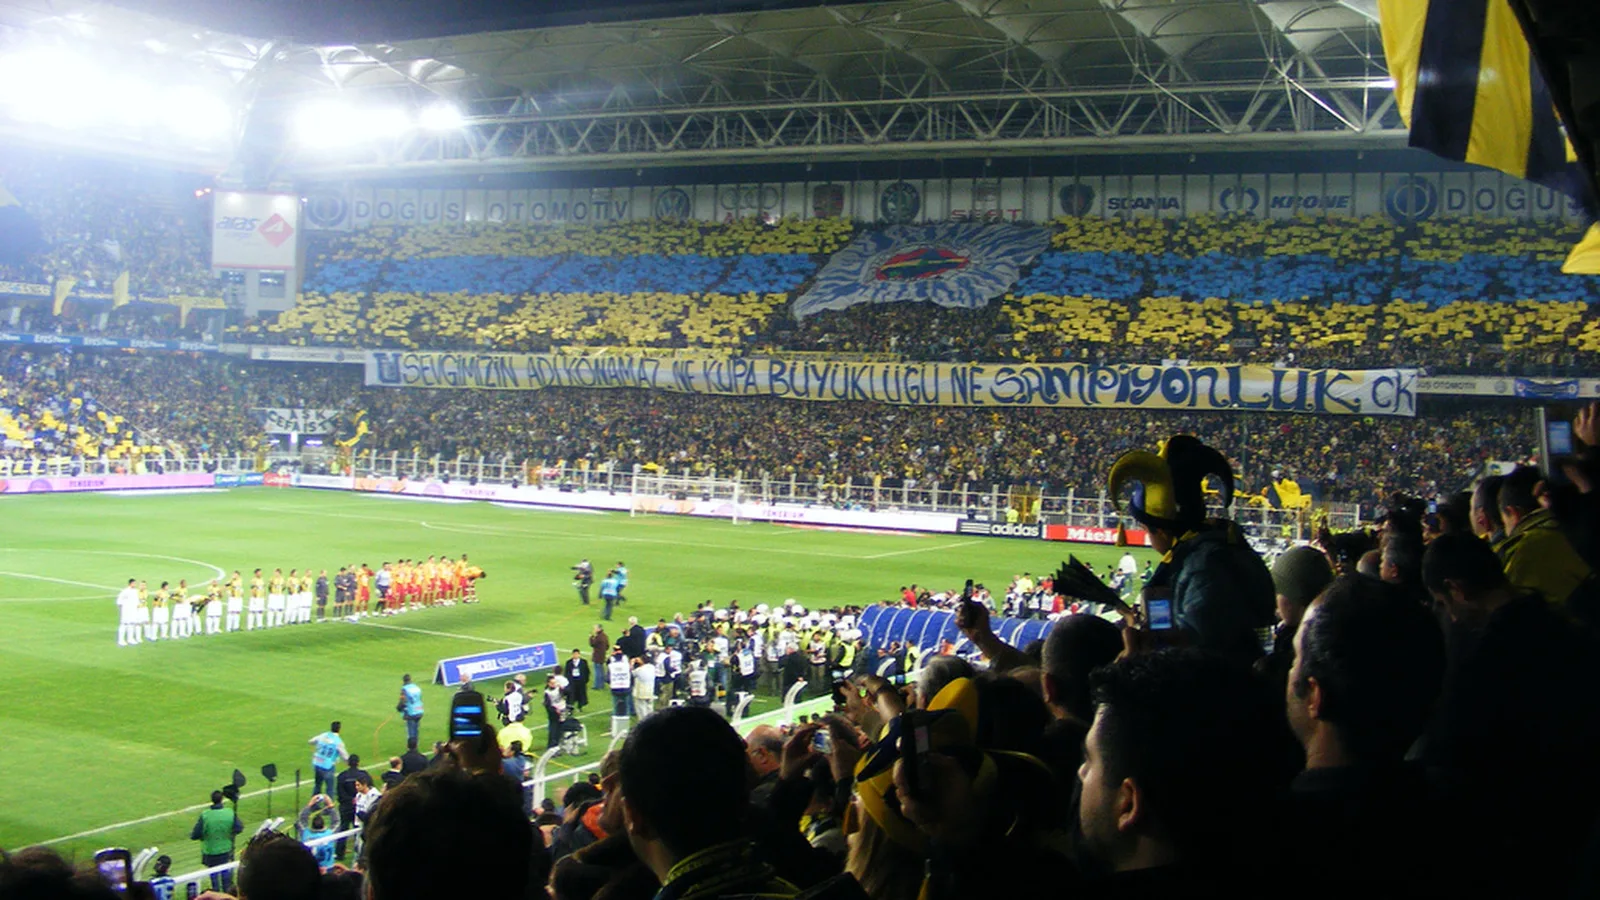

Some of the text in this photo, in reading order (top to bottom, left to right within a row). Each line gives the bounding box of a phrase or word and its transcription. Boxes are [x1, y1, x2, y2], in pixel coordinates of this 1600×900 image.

[1107, 196, 1180, 210] SCANIA
[1270, 195, 1350, 209] KRONE
[703, 358, 759, 394] KUPA
[950, 365, 985, 405] NE
[990, 522, 1040, 537] adidas
